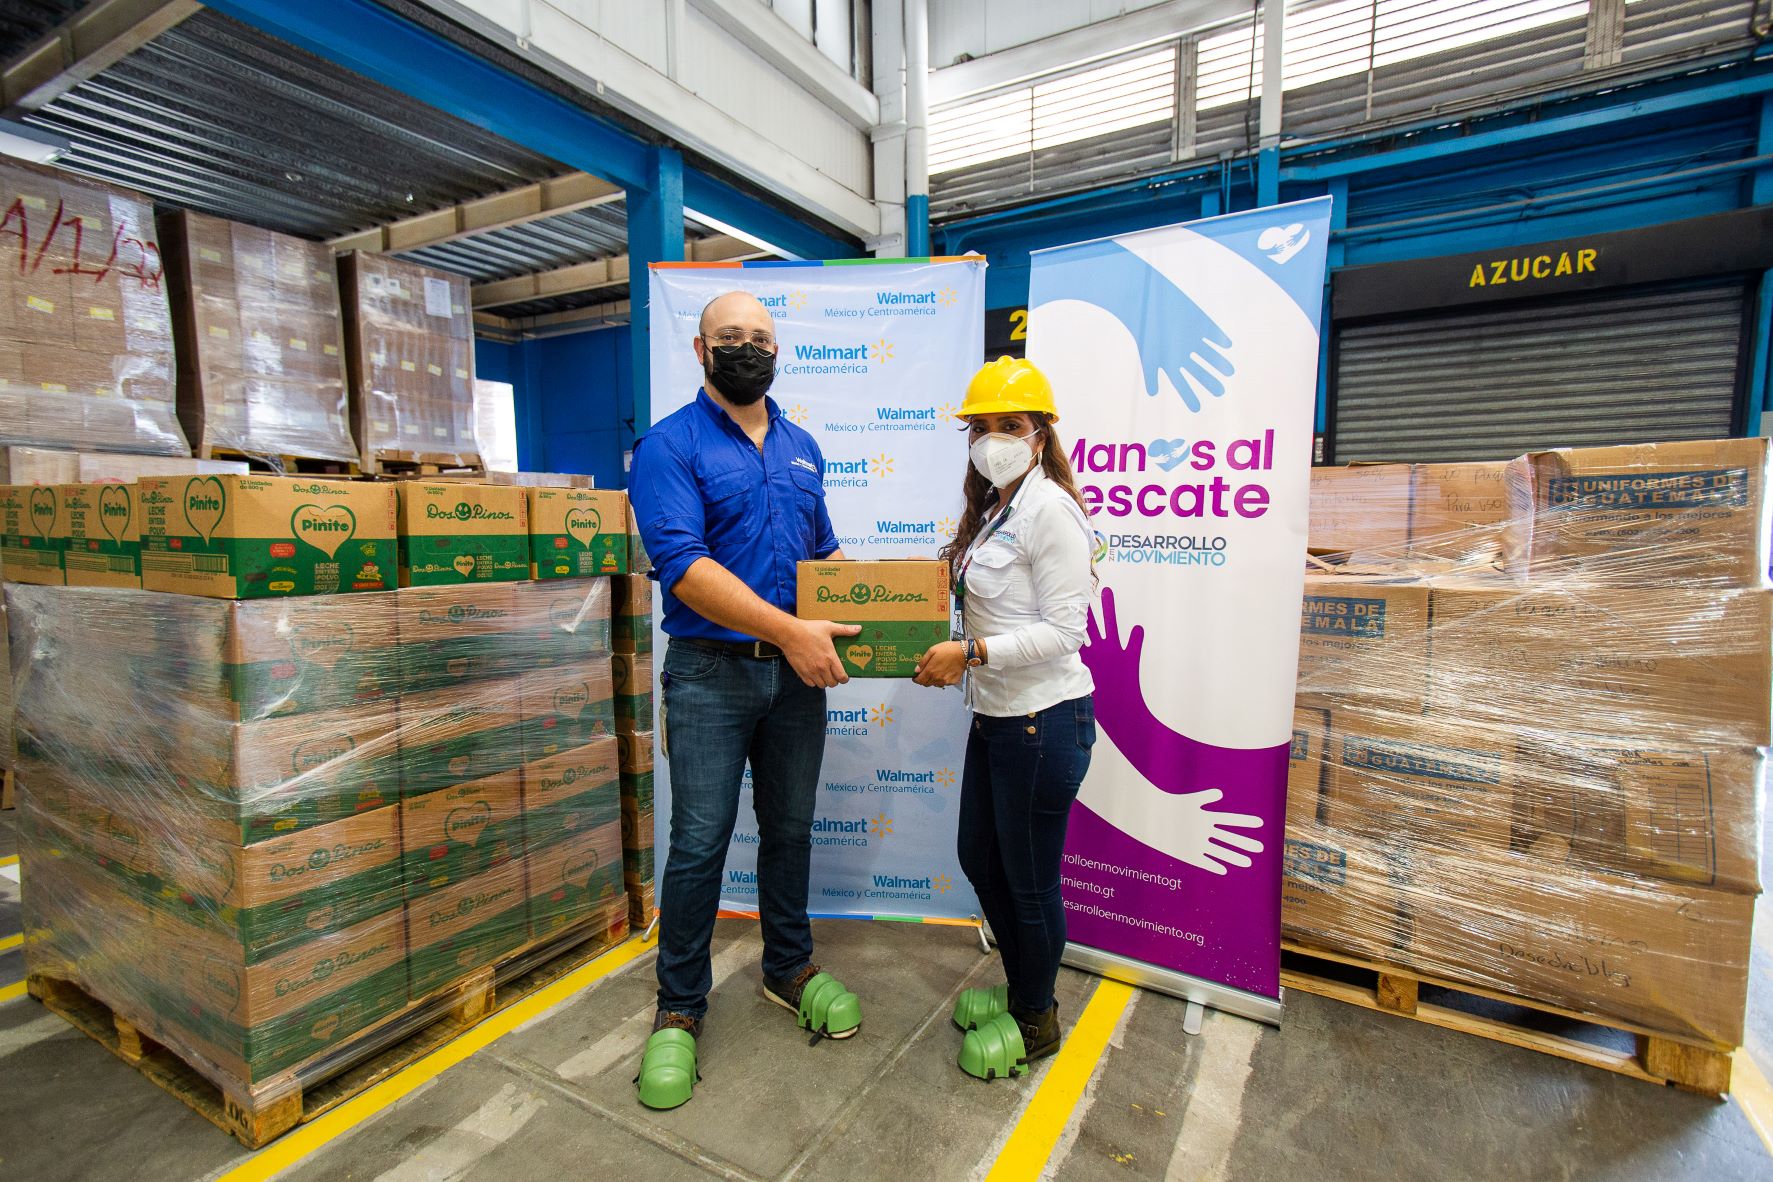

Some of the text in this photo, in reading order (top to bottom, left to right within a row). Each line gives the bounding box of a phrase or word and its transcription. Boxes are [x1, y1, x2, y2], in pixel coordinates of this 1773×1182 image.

[1469, 248, 1597, 288] AZUCAR
[757, 294, 787, 306] mart
[877, 291, 936, 304] Walmart
[824, 306, 936, 319] México y Centroamérica
[795, 344, 868, 360] Walmart
[784, 363, 868, 374] Centroamérica
[877, 407, 936, 420] Walmart
[825, 422, 936, 433] México y Centroamérica
[1226, 429, 1274, 471] al
[824, 458, 868, 474] lmart
[293, 483, 350, 495] Dos Pinos
[823, 477, 868, 488] américa
[1583, 476, 1706, 492] UNIFORMES
[190, 495, 220, 511] Pinito
[1081, 476, 1270, 519] escate
[427, 503, 514, 519] Dos Pinos
[302, 519, 349, 532] Pinito
[877, 521, 936, 533] Walmart
[835, 535, 936, 546] éxico y Centroamérica
[1109, 535, 1227, 551] DESARROLLO
[1117, 549, 1226, 567] MOVIMIENTO
[817, 585, 928, 603] Dos Pinos
[1354, 603, 1380, 617] DE
[1301, 615, 1379, 632] EMALA
[828, 708, 868, 723] mart
[826, 726, 868, 736] américa
[877, 769, 934, 783] Walmart
[825, 783, 934, 794] México y Centroamérica
[812, 817, 867, 833] almart
[733, 833, 760, 844] Méxi
[812, 836, 867, 847] roamérica
[1316, 849, 1340, 865] DE
[1061, 853, 1182, 890] rolloenmovimientogt
[873, 875, 931, 889] Walmart
[1060, 874, 1115, 898] imiento.gt
[822, 888, 931, 900] México y Centroamérica
[1062, 897, 1204, 946] esarrolloenmovimiento.org
